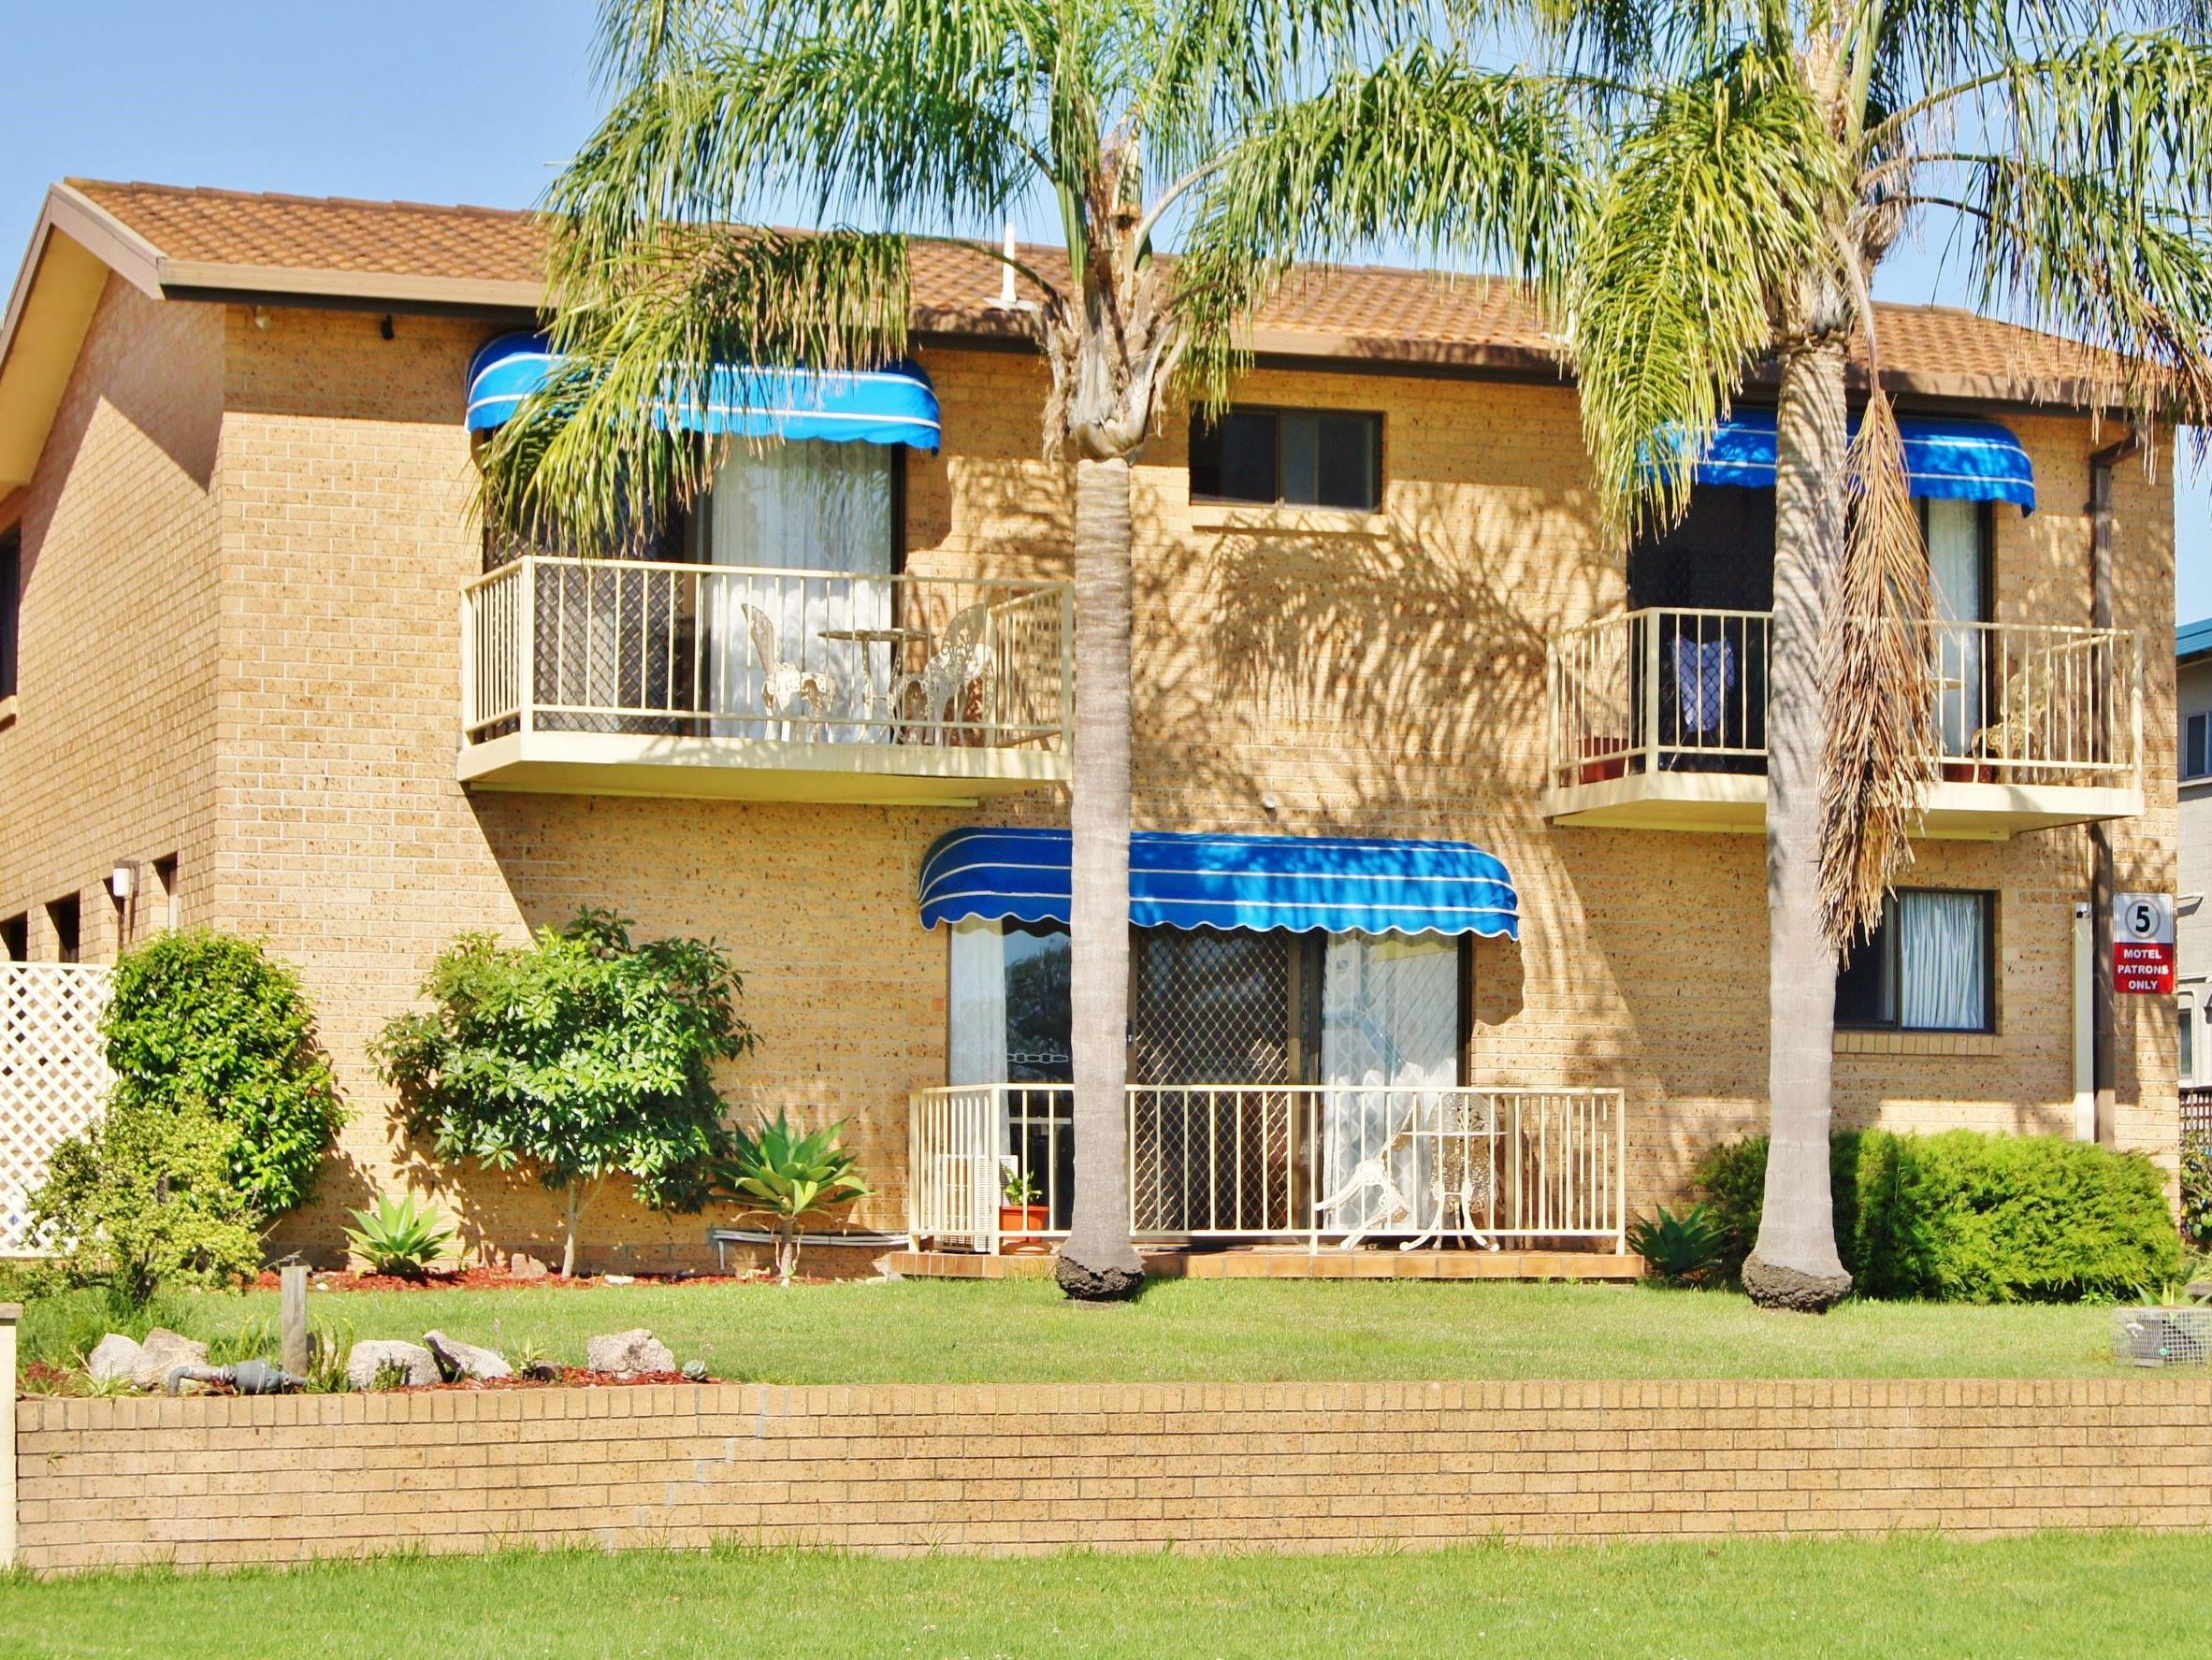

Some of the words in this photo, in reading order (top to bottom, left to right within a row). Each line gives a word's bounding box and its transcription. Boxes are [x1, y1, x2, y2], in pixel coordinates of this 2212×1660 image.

[2135, 905, 2150, 932] 5
[2123, 949, 2162, 959] MOTEL
[2118, 964, 2169, 974] PATRONS
[2128, 980, 2158, 989] ONLY
